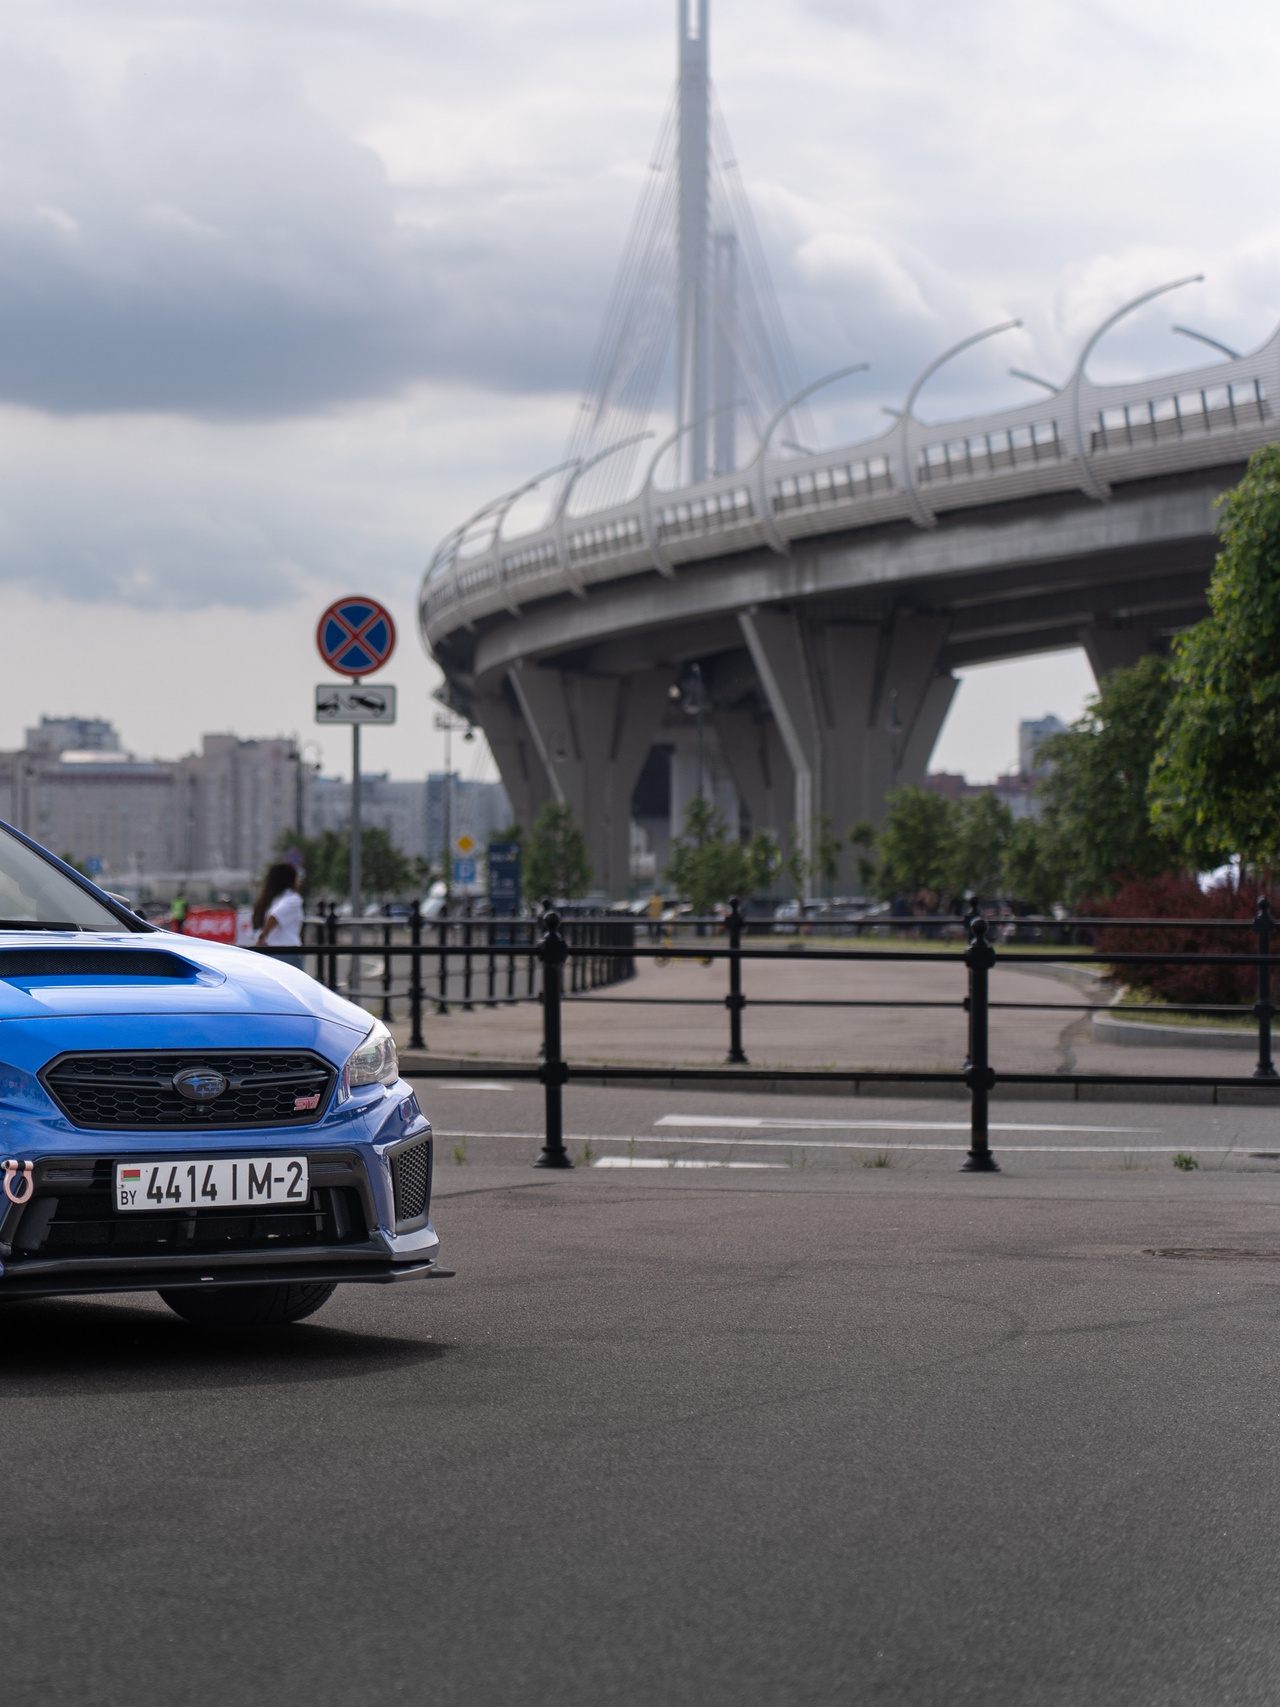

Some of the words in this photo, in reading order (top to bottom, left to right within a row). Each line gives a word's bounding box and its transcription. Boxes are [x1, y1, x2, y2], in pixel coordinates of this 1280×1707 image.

[146, 1165, 218, 1204] 4414
[232, 1161, 303, 1200] IM-2
[121, 1191, 136, 1205] BY
